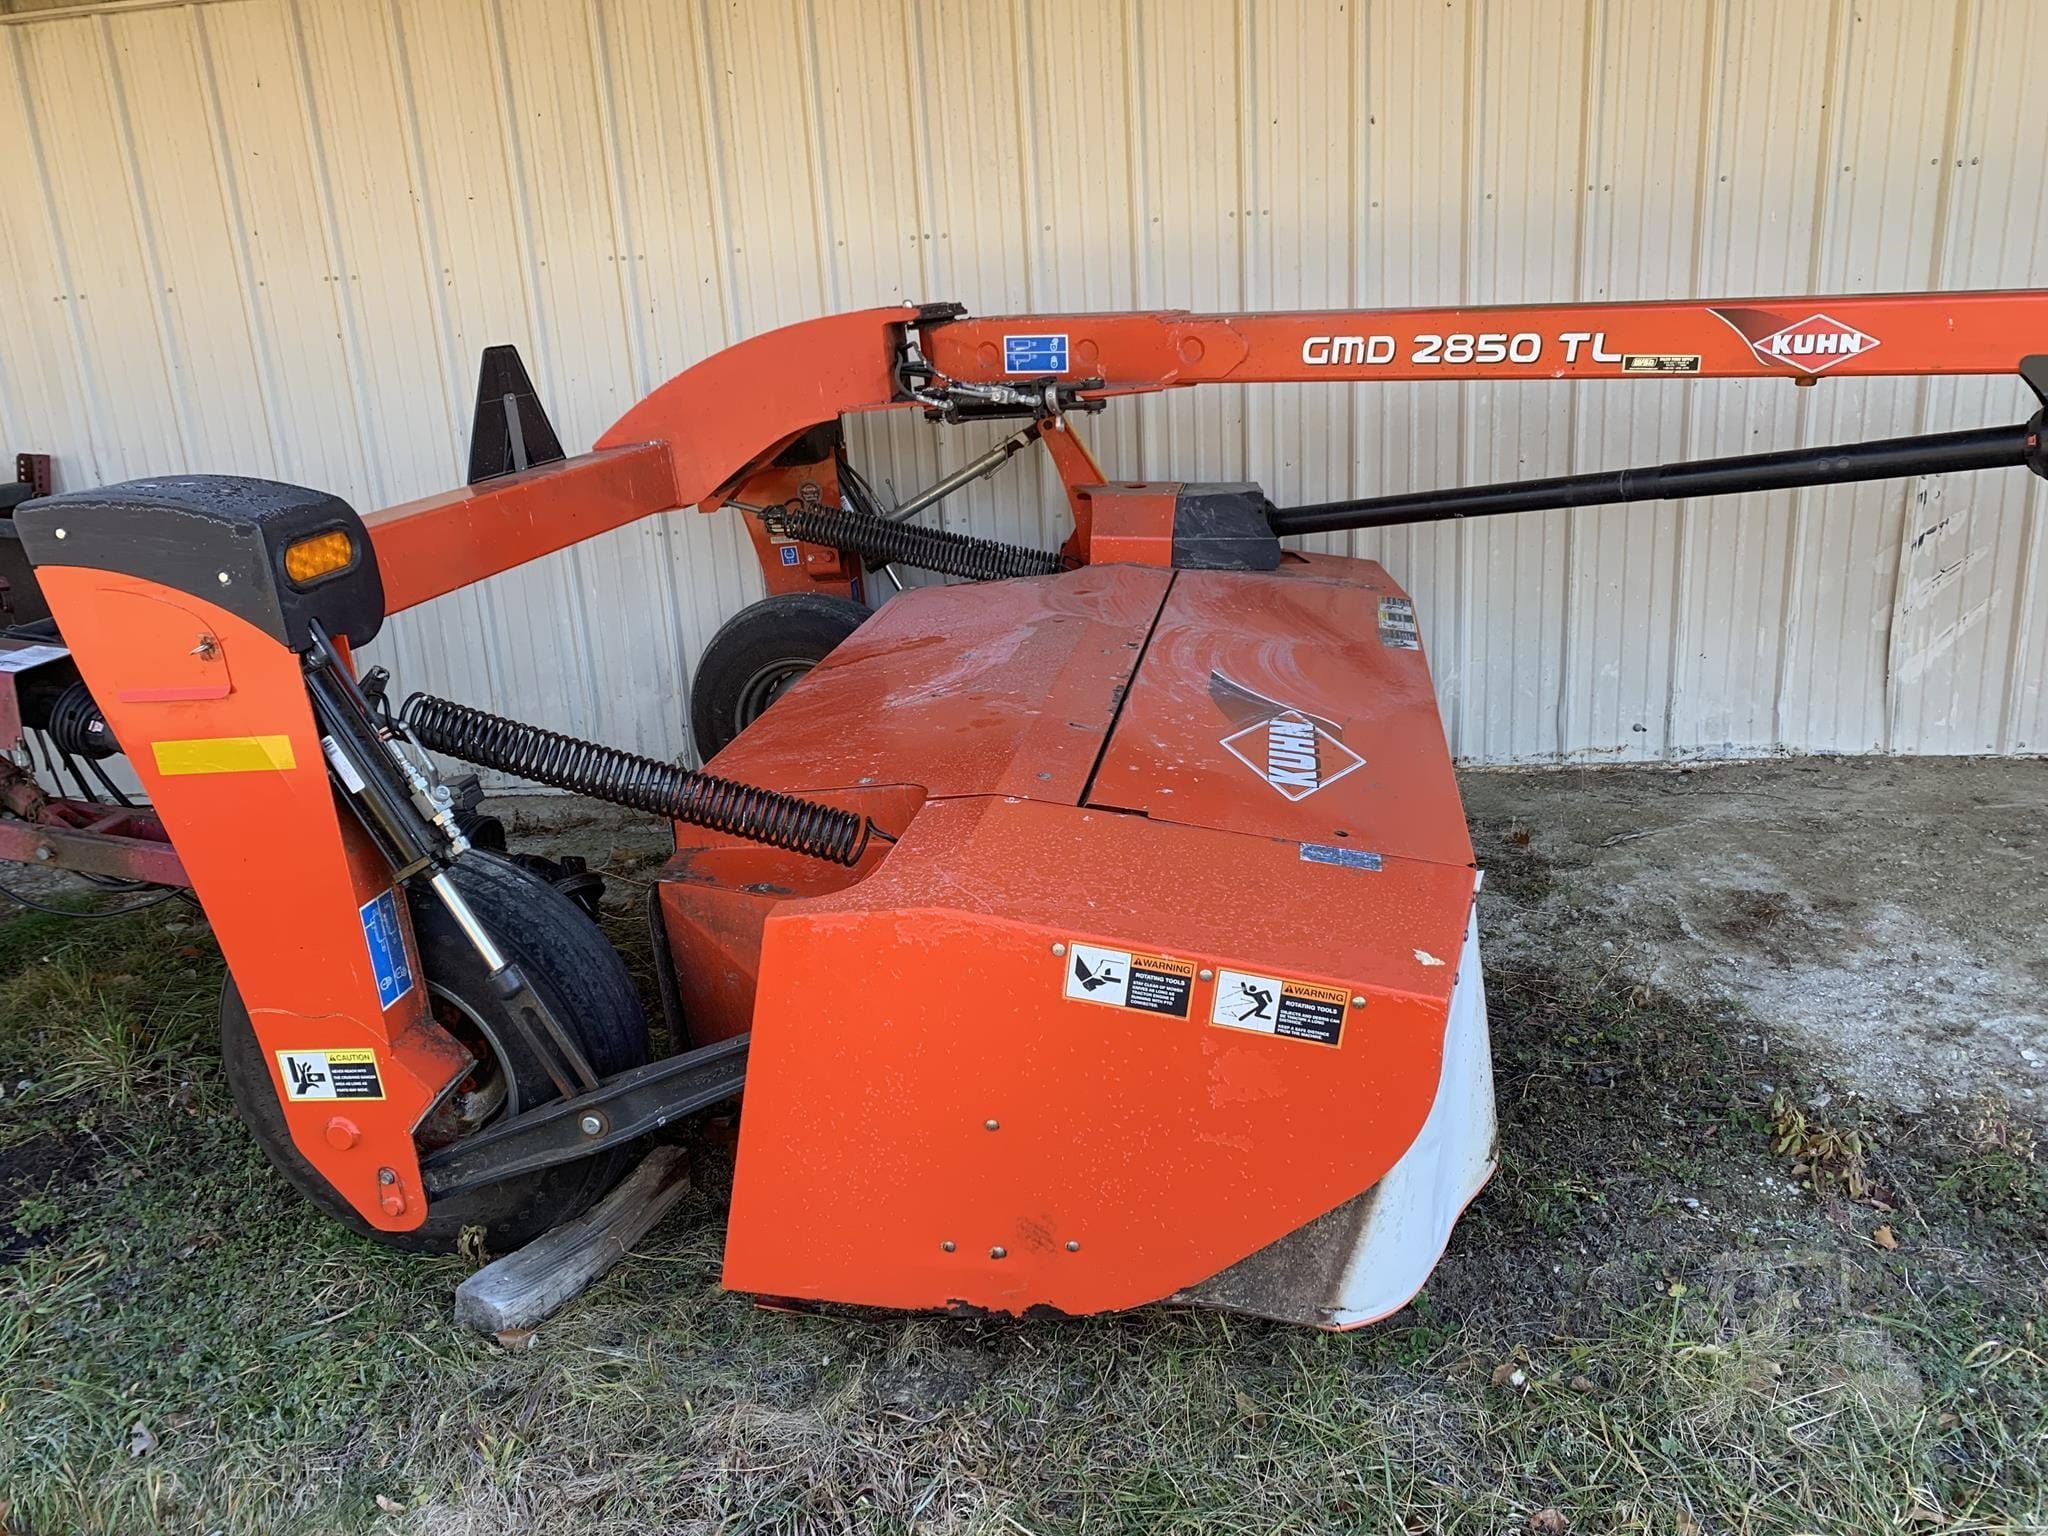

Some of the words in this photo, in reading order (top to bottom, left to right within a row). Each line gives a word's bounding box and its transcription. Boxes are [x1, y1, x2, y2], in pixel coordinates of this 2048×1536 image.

[1302, 336, 1395, 364] GMD
[1411, 334, 1542, 363] 2850
[1558, 333, 1622, 362] TL
[1772, 334, 1861, 355] KUHN
[1268, 720, 1319, 788] KUHN
[1144, 959, 1190, 974] WARNING
[1135, 973, 1164, 982] ROTATING
[1165, 977, 1185, 986] TOOLS
[1295, 986, 1344, 1002] WARNING
[1286, 1001, 1315, 1010] ROTATING
[1317, 1006, 1337, 1014] TOOLS
